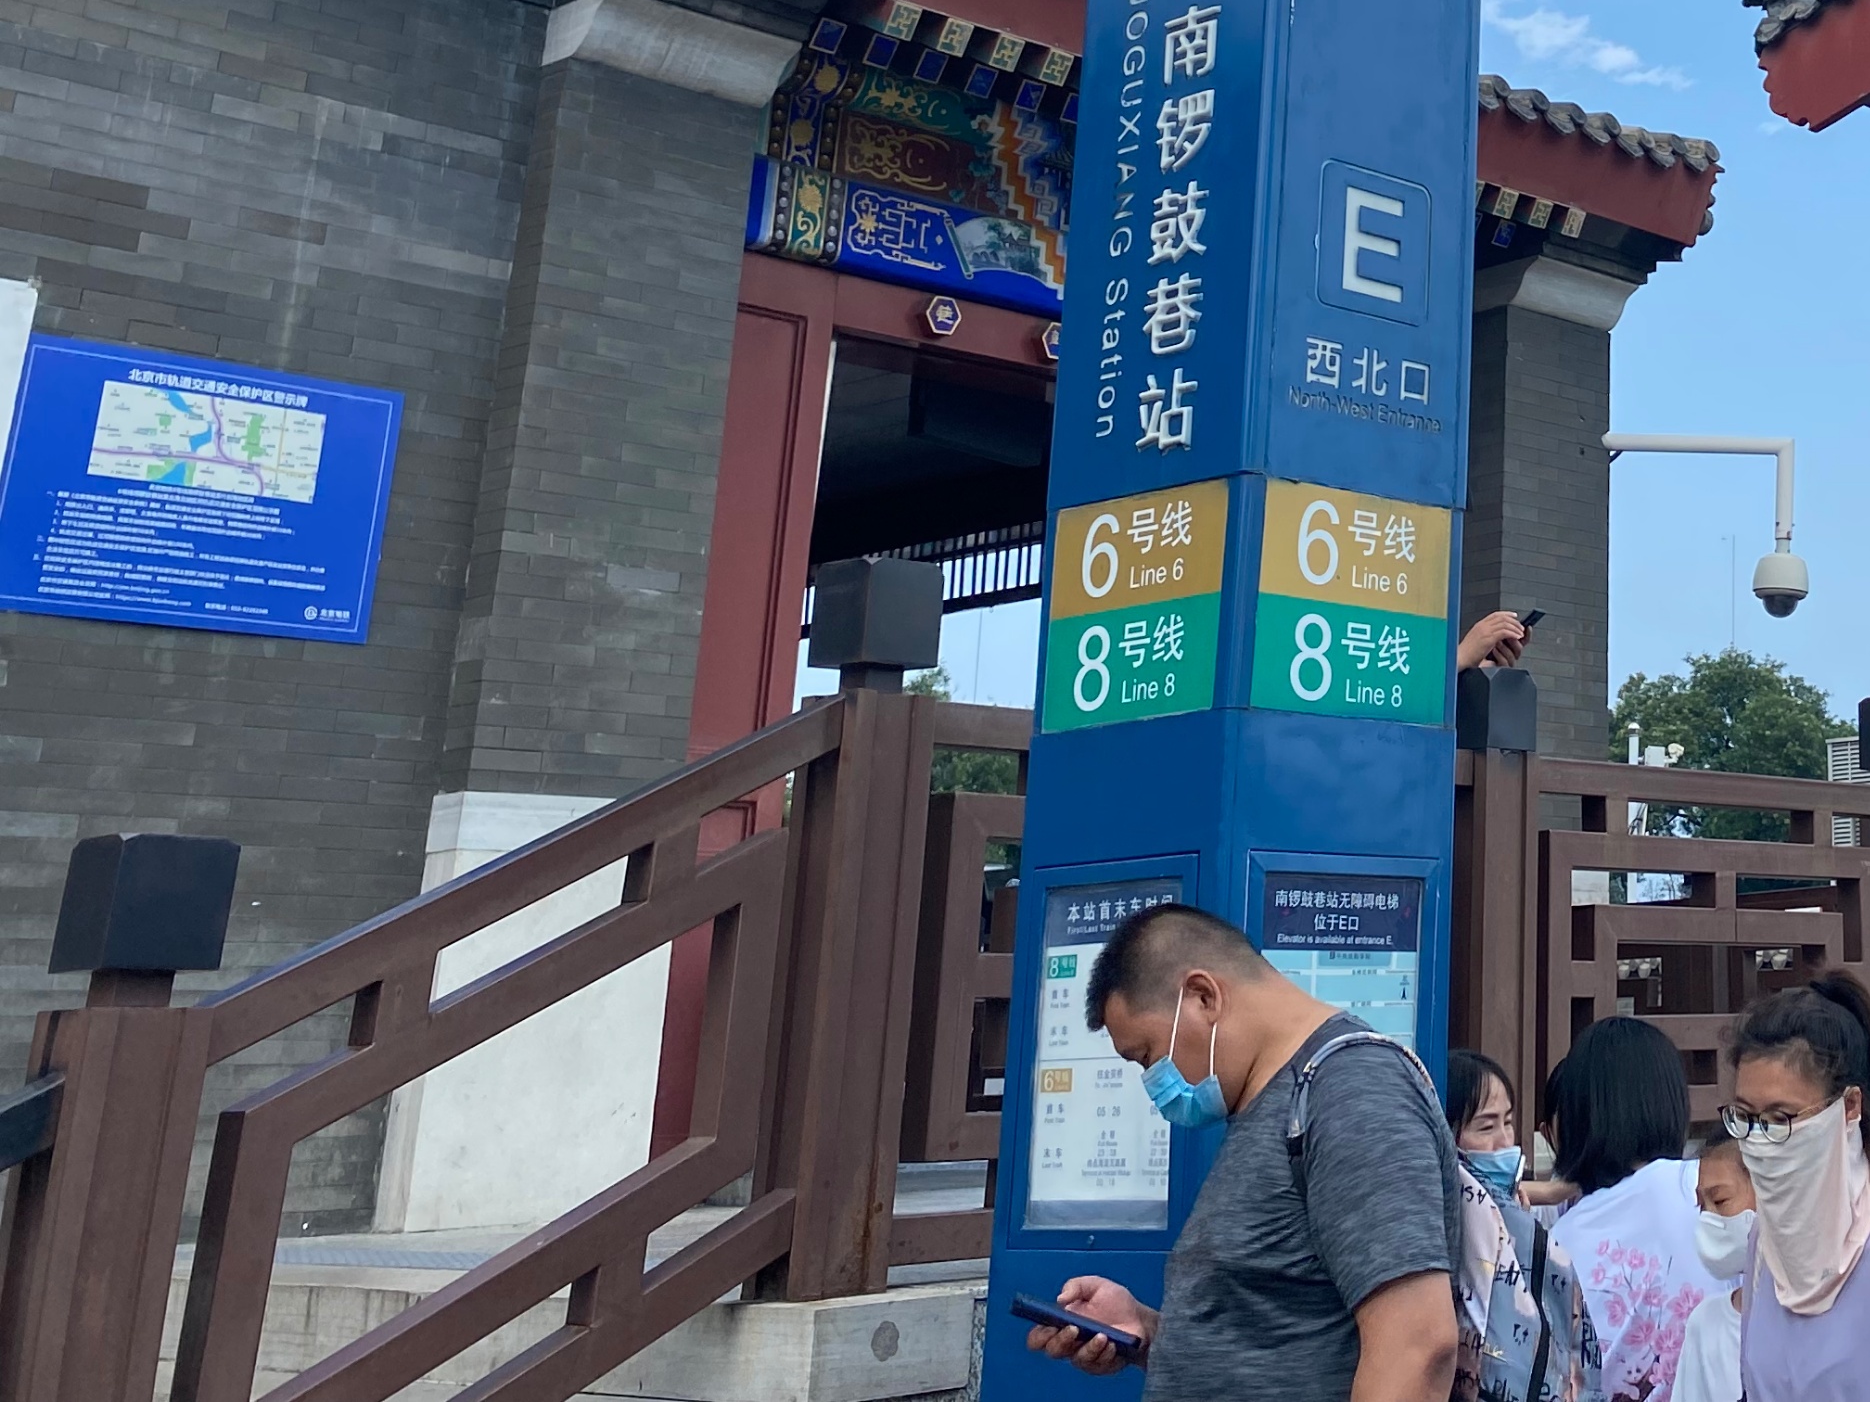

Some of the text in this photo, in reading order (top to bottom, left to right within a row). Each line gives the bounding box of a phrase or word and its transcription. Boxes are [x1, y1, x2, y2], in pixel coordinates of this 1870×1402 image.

[1342, 185, 1404, 304] E
[1096, 278, 1129, 438] Station
[1306, 337, 1430, 405] 西北口
[1289, 385, 1442, 434] North-West Entrance
[1129, 557, 1184, 589] Line 6
[1351, 565, 1408, 595] Line 6
[1121, 673, 1175, 703] Line 8
[1345, 678, 1402, 707] Line 8
[1275, 889, 1399, 910] 南锣鼓巷站无障碍电梯
[1314, 914, 1359, 931] 位于E口
[1277, 933, 1306, 943] Elevator
[1307, 934, 1313, 944] is
